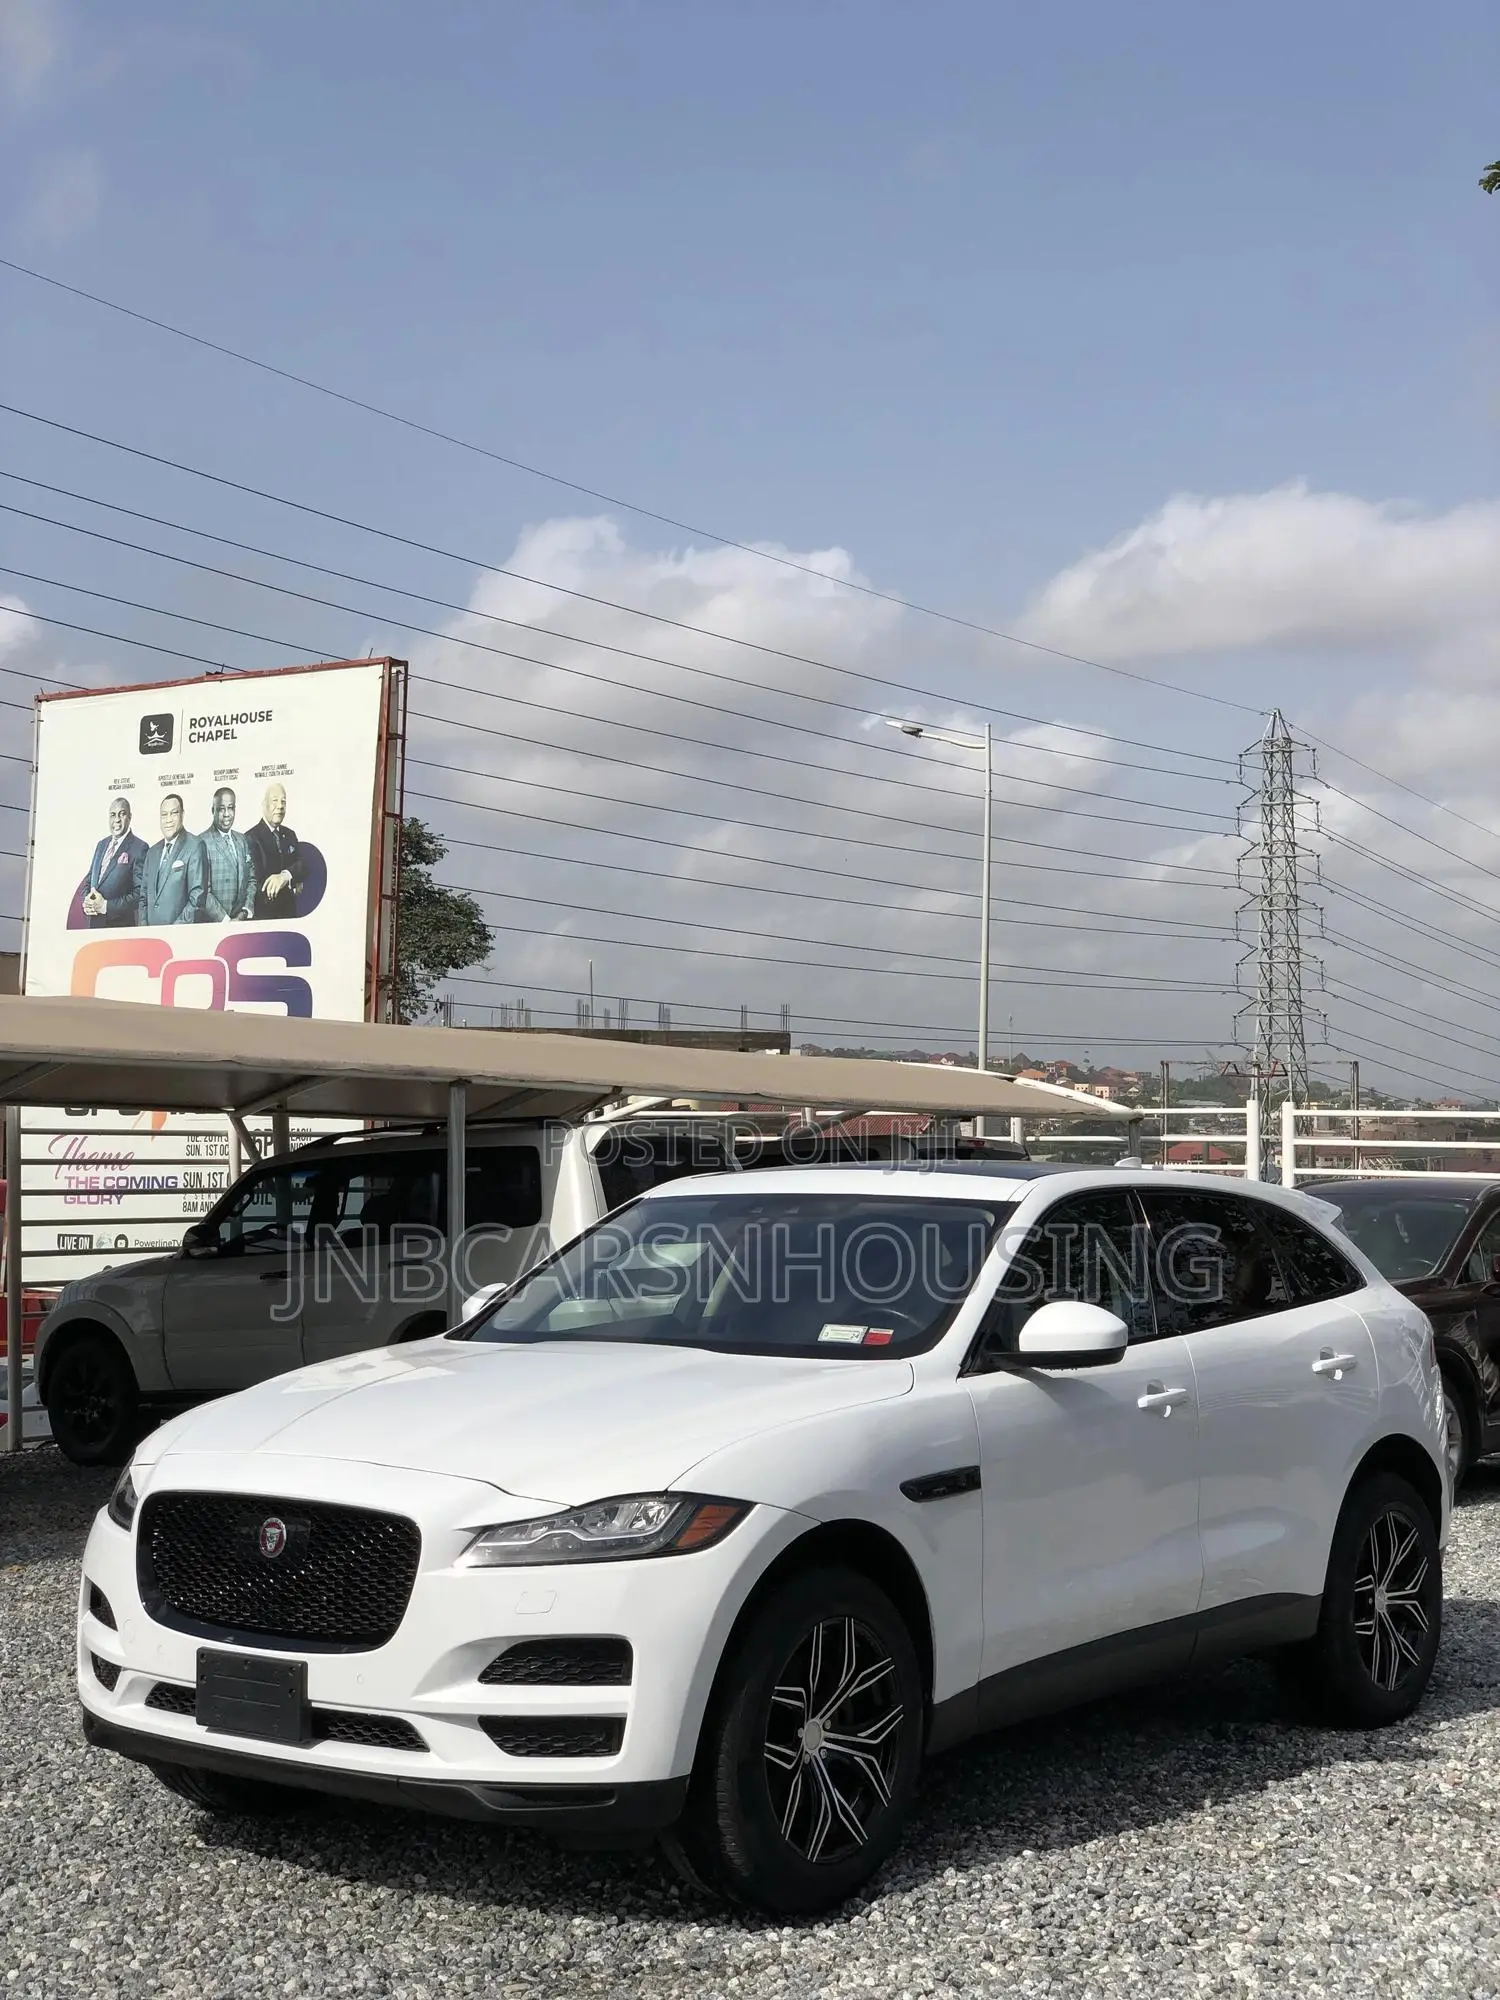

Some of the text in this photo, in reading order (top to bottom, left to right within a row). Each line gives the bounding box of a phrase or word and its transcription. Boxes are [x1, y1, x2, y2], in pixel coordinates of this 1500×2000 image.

[189, 710, 273, 730] ROYALHOUSE
[188, 728, 238, 744] CHAPEL
[48, 1135, 135, 1180] Theme
[186, 1144, 229, 1157] SUN. 1ST OC
[64, 1176, 178, 1189] THE COMING
[183, 1171, 205, 1188] SUN.
[207, 1171, 224, 1188] 1ST
[64, 1193, 124, 1205] GLORY
[182, 1201, 199, 1213] 8AM
[59, 1236, 90, 1250] LIVE ON
